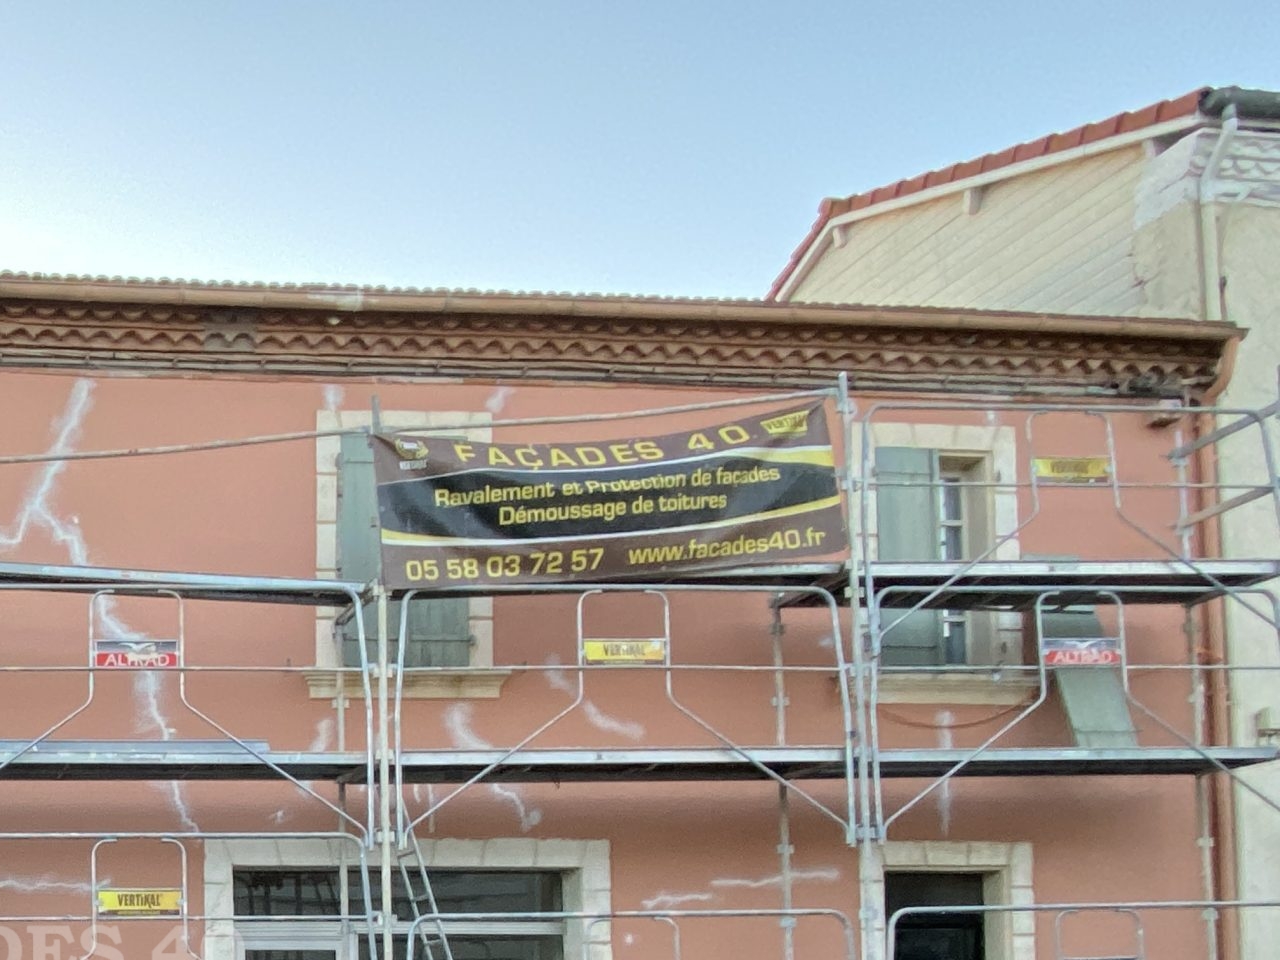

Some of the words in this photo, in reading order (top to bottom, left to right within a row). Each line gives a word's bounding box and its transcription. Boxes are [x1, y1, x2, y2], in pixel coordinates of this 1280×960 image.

[455, 442, 663, 470] FAÇADES
[687, 424, 750, 450] 40
[434, 482, 554, 507] Ravalement
[562, 481, 583, 496] et
[587, 474, 686, 494] Protection
[691, 470, 712, 487] de
[717, 467, 780, 488] façades
[499, 499, 626, 526] Démoussage
[632, 497, 653, 514] de
[659, 492, 726, 512] toitures
[406, 560, 439, 581] 05
[447, 557, 479, 578] 58
[487, 554, 520, 577] 03
[530, 551, 562, 574] 72
[571, 548, 604, 571] 57
[629, 529, 826, 564] www.facades40.fr
[117, 893, 161, 908] VERTIKAL
